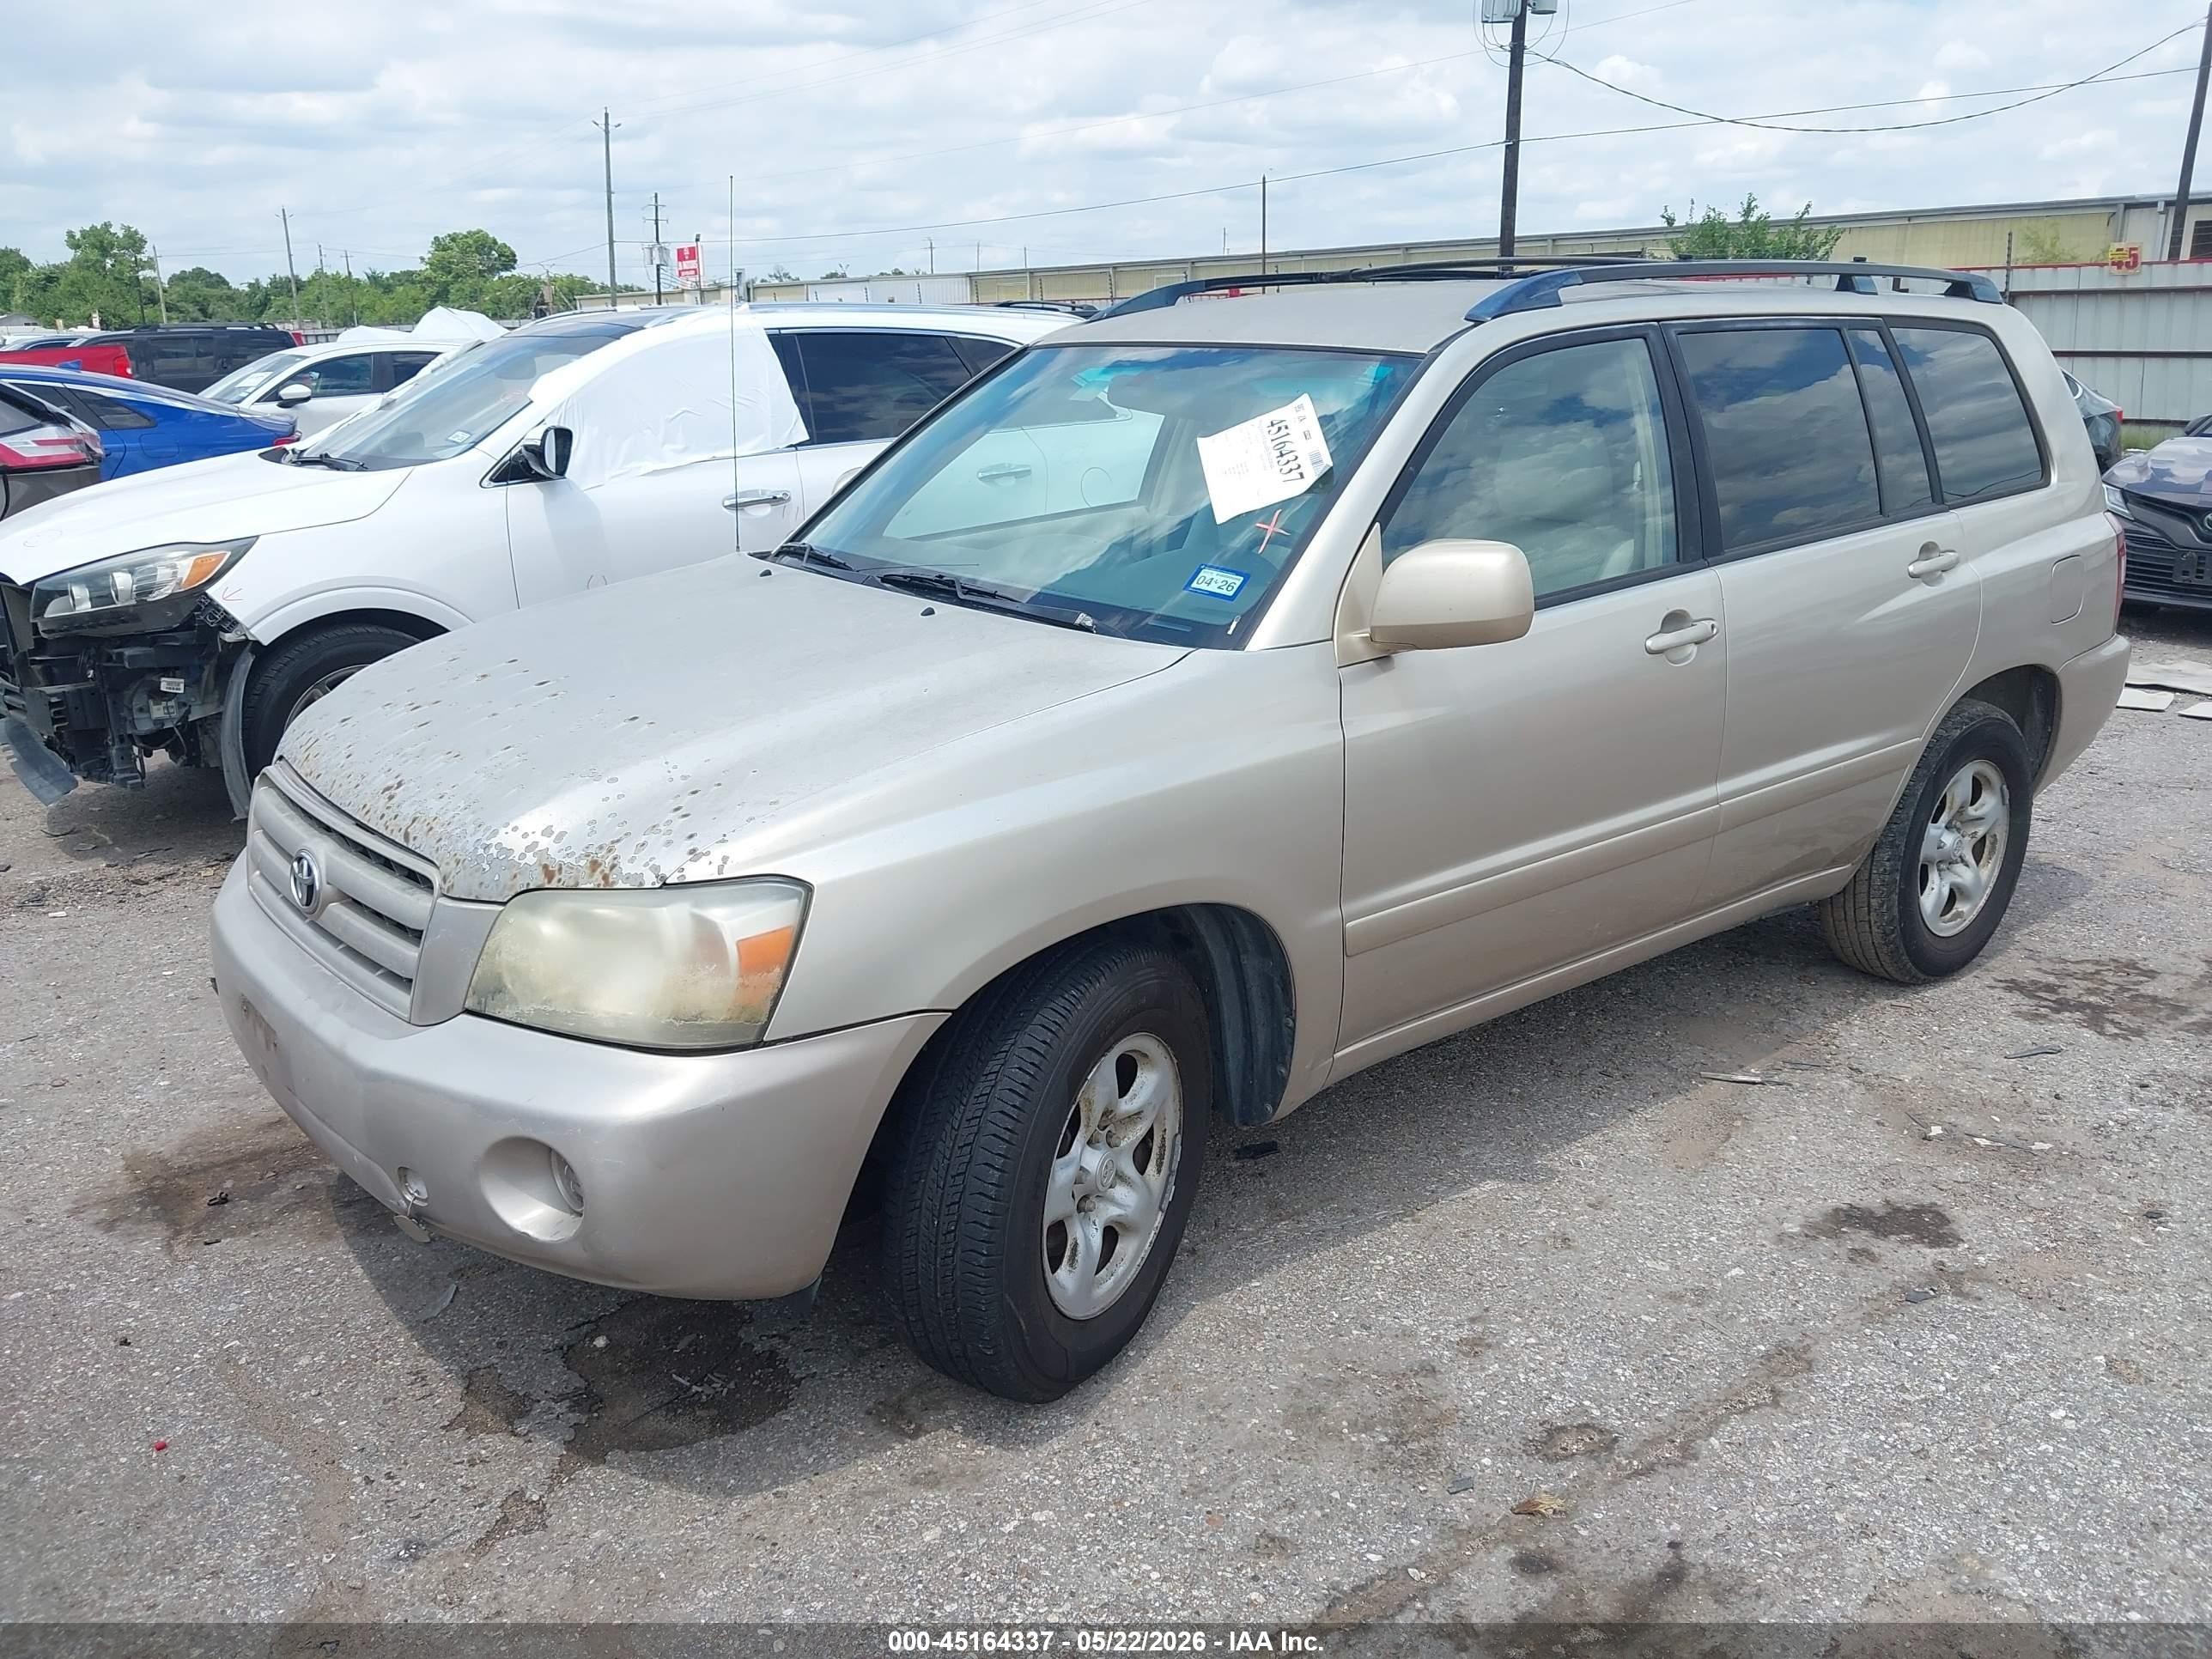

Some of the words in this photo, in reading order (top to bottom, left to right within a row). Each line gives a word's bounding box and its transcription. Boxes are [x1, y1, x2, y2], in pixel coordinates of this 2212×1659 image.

[1266, 418, 1305, 483] 45164337
[1195, 575, 1214, 587] 04
[1217, 580, 1237, 592] 26
